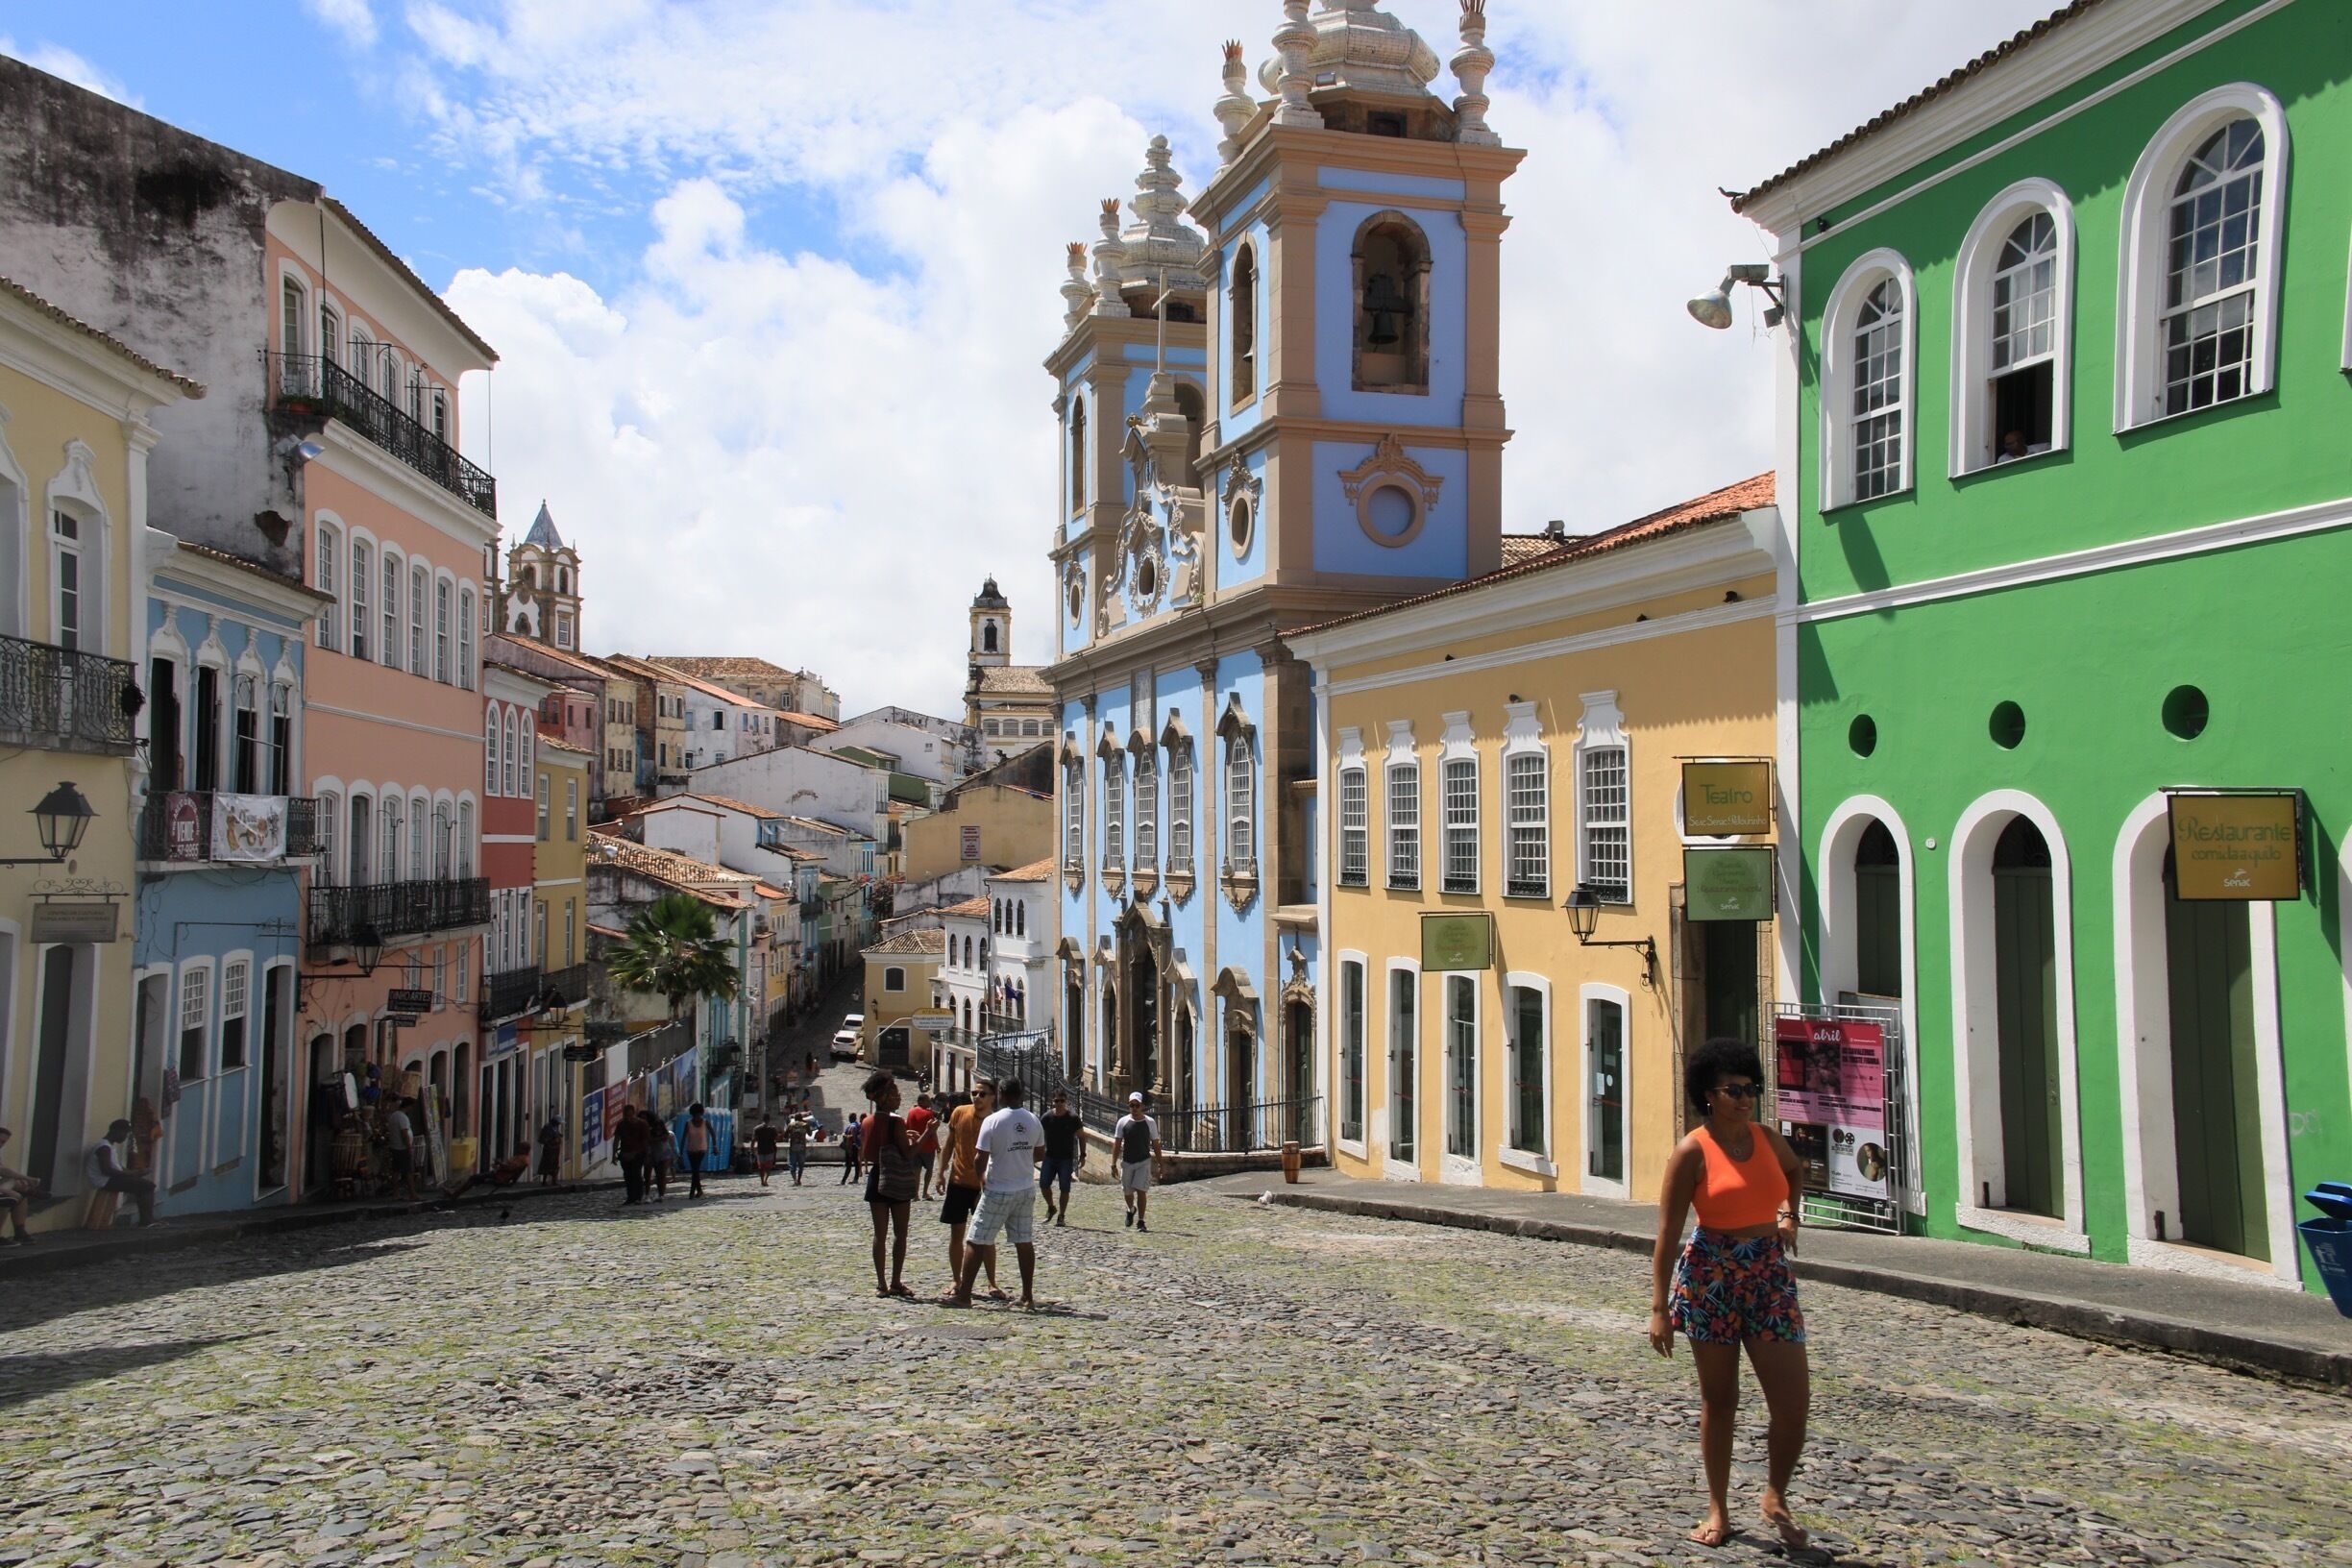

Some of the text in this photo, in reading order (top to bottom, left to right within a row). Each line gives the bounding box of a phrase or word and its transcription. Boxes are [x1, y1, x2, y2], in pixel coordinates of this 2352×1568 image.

[1700, 784, 1753, 805] Teatro
[2177, 816, 2291, 842] Restaurante
[2192, 845, 2282, 868] comida a quilo
[1813, 1028, 1842, 1042] abril
